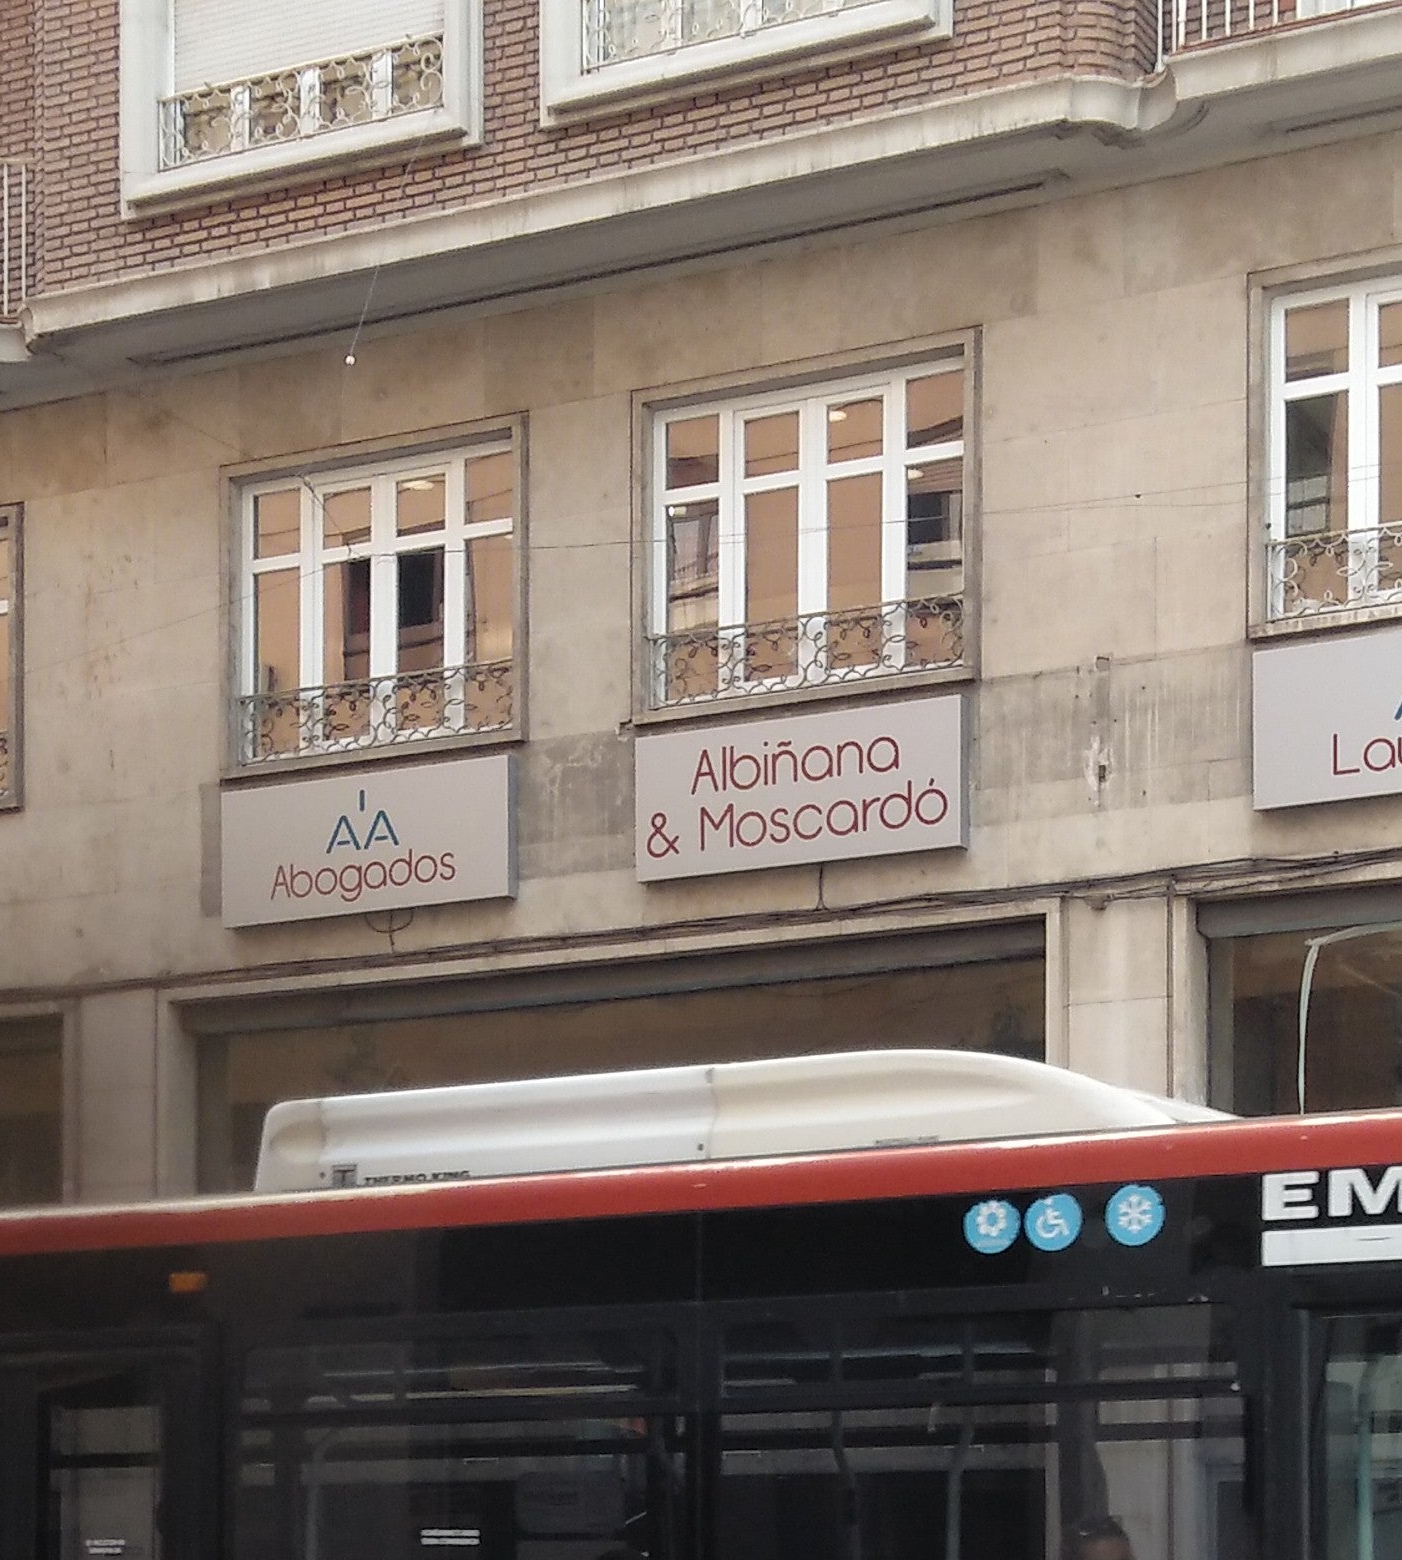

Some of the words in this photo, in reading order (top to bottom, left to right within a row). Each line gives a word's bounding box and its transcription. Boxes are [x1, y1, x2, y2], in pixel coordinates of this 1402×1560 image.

[691, 734, 900, 796] Albiñana
[647, 811, 681, 859] &
[699, 777, 949, 852] Moscardó
[270, 849, 457, 903] Abogados
